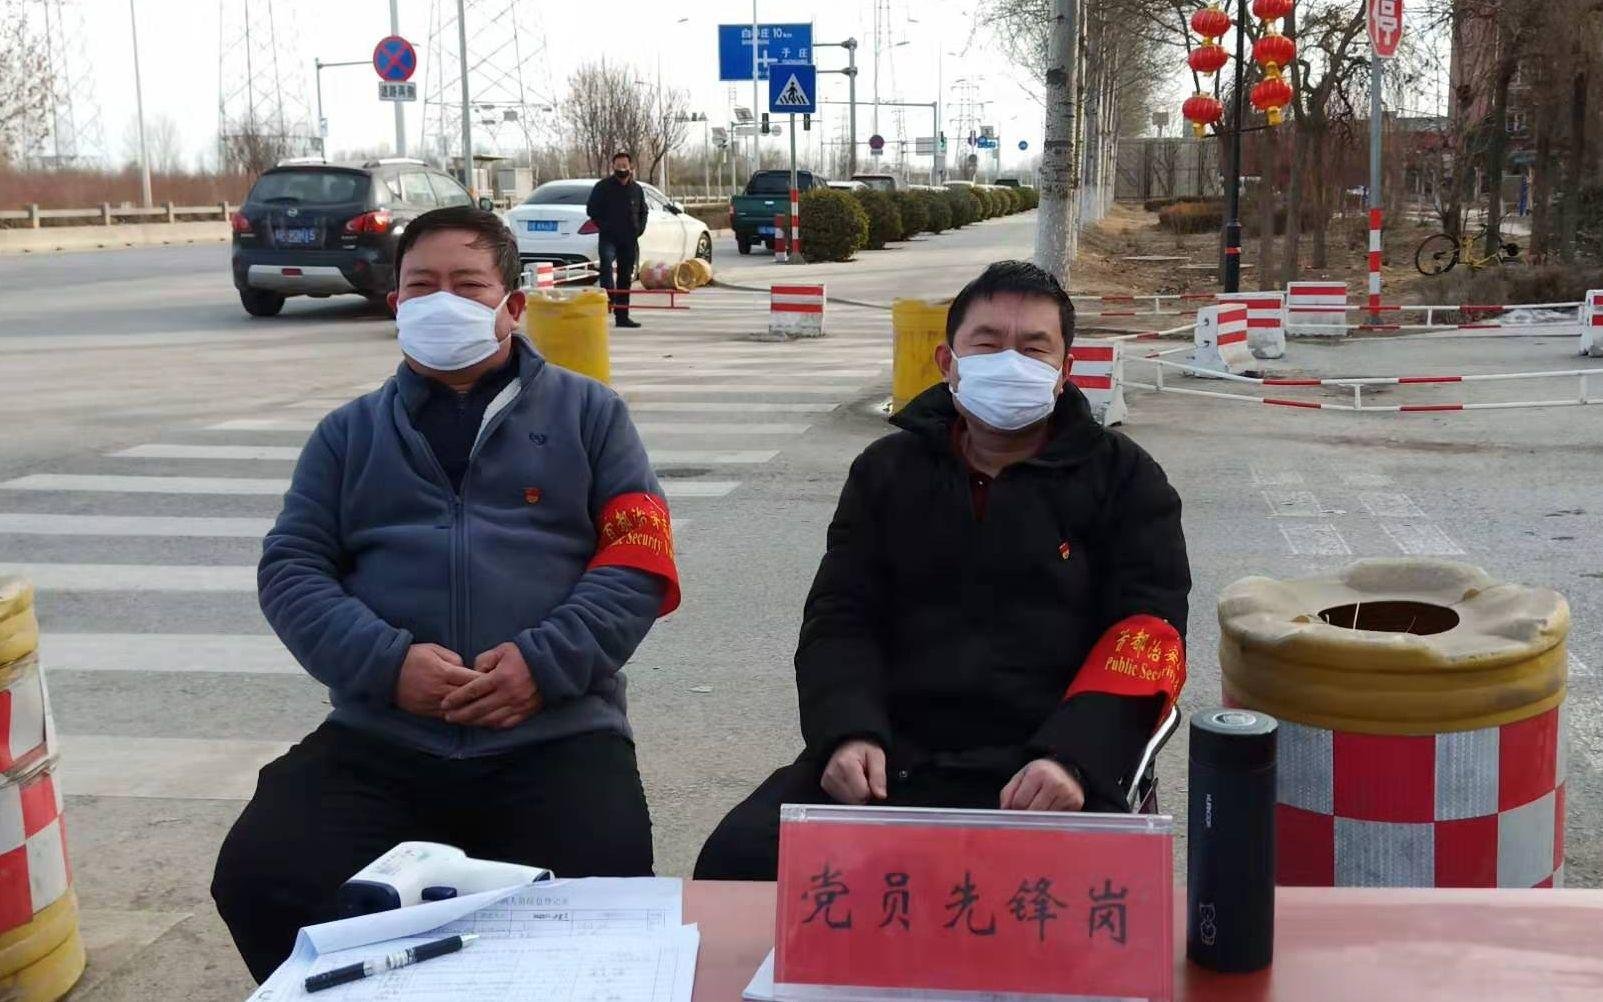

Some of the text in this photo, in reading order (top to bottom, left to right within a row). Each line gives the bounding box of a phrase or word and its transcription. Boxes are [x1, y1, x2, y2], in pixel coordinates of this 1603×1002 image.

[741, 28, 769, 39] 白庄
[772, 28, 782, 39] 10
[625, 532, 662, 556] Security
[1104, 656, 1138, 677] Public
[800, 861, 1129, 944] 党员先锋岗
